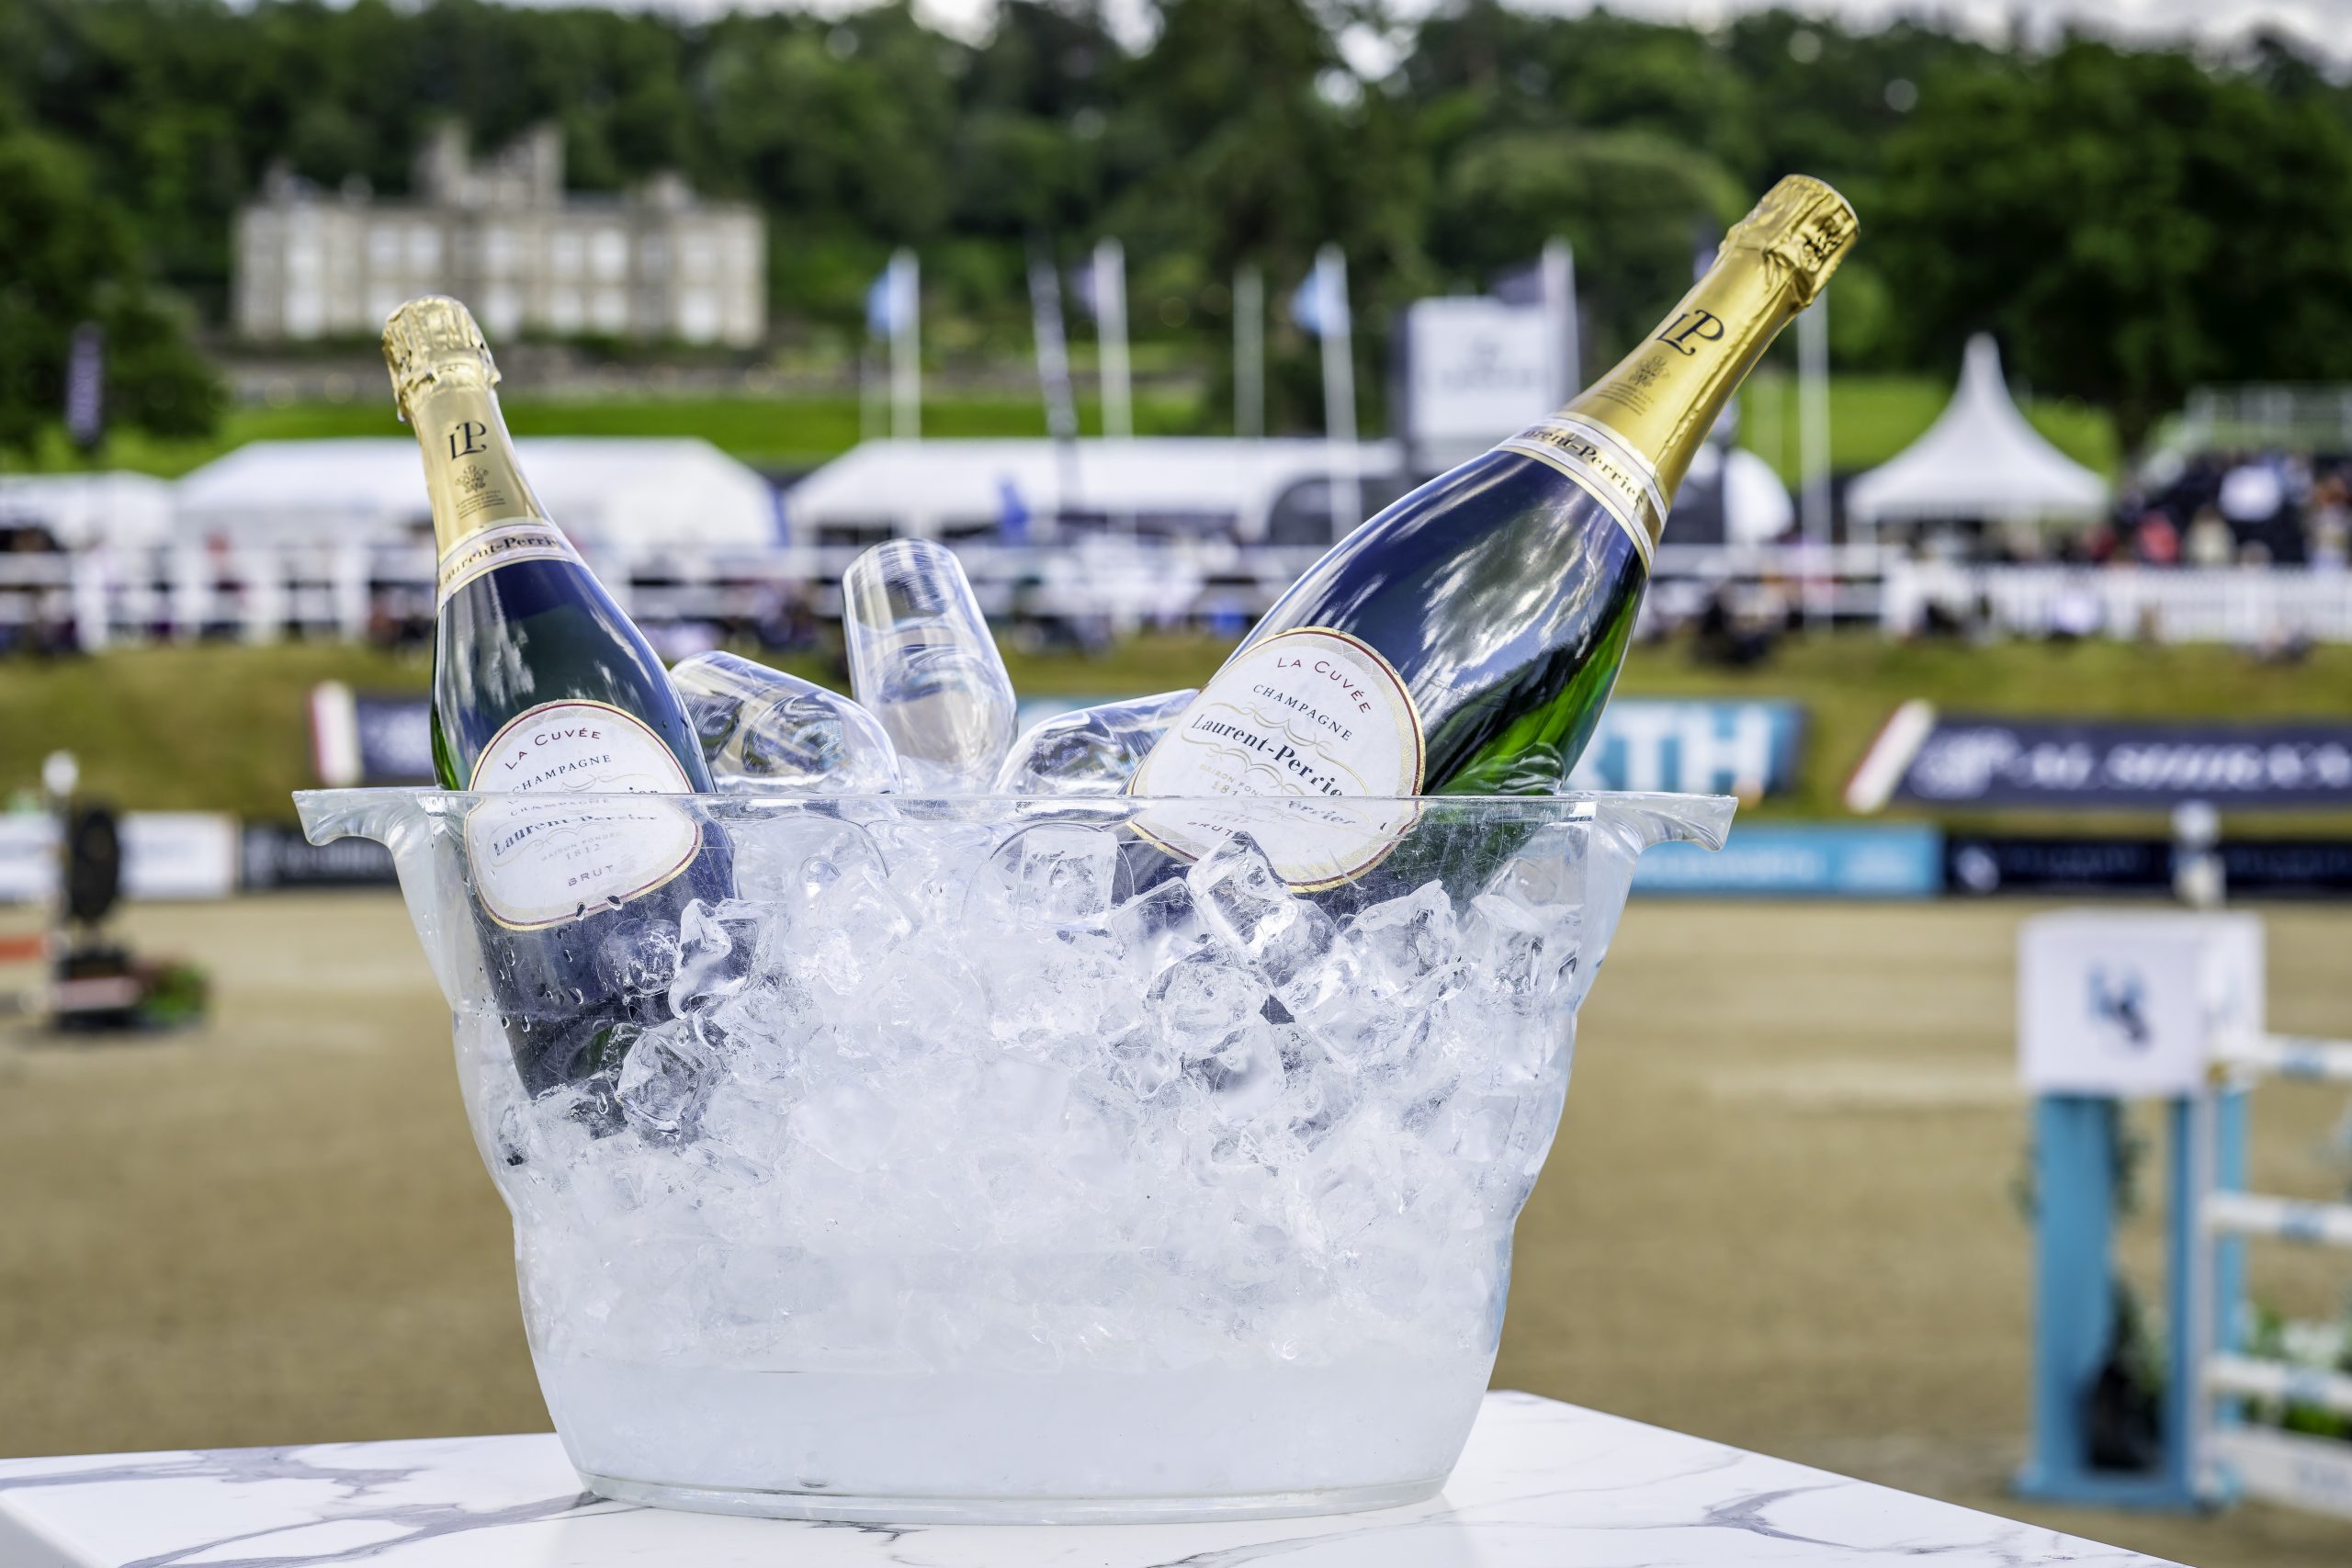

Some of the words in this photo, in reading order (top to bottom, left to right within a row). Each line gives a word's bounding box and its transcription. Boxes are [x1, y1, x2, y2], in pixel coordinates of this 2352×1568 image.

[1277, 657, 1302, 668] LA
[1314, 660, 1371, 714] CUVÉE
[1252, 683, 1352, 741] CHAMPAGNE
[504, 750, 528, 771] LA
[534, 728, 602, 747] CUVÉE
[511, 754, 611, 793] CHAMPAGNE
[1191, 713, 1343, 796] Laurent-Perrie
[568, 864, 615, 887] BRUT
